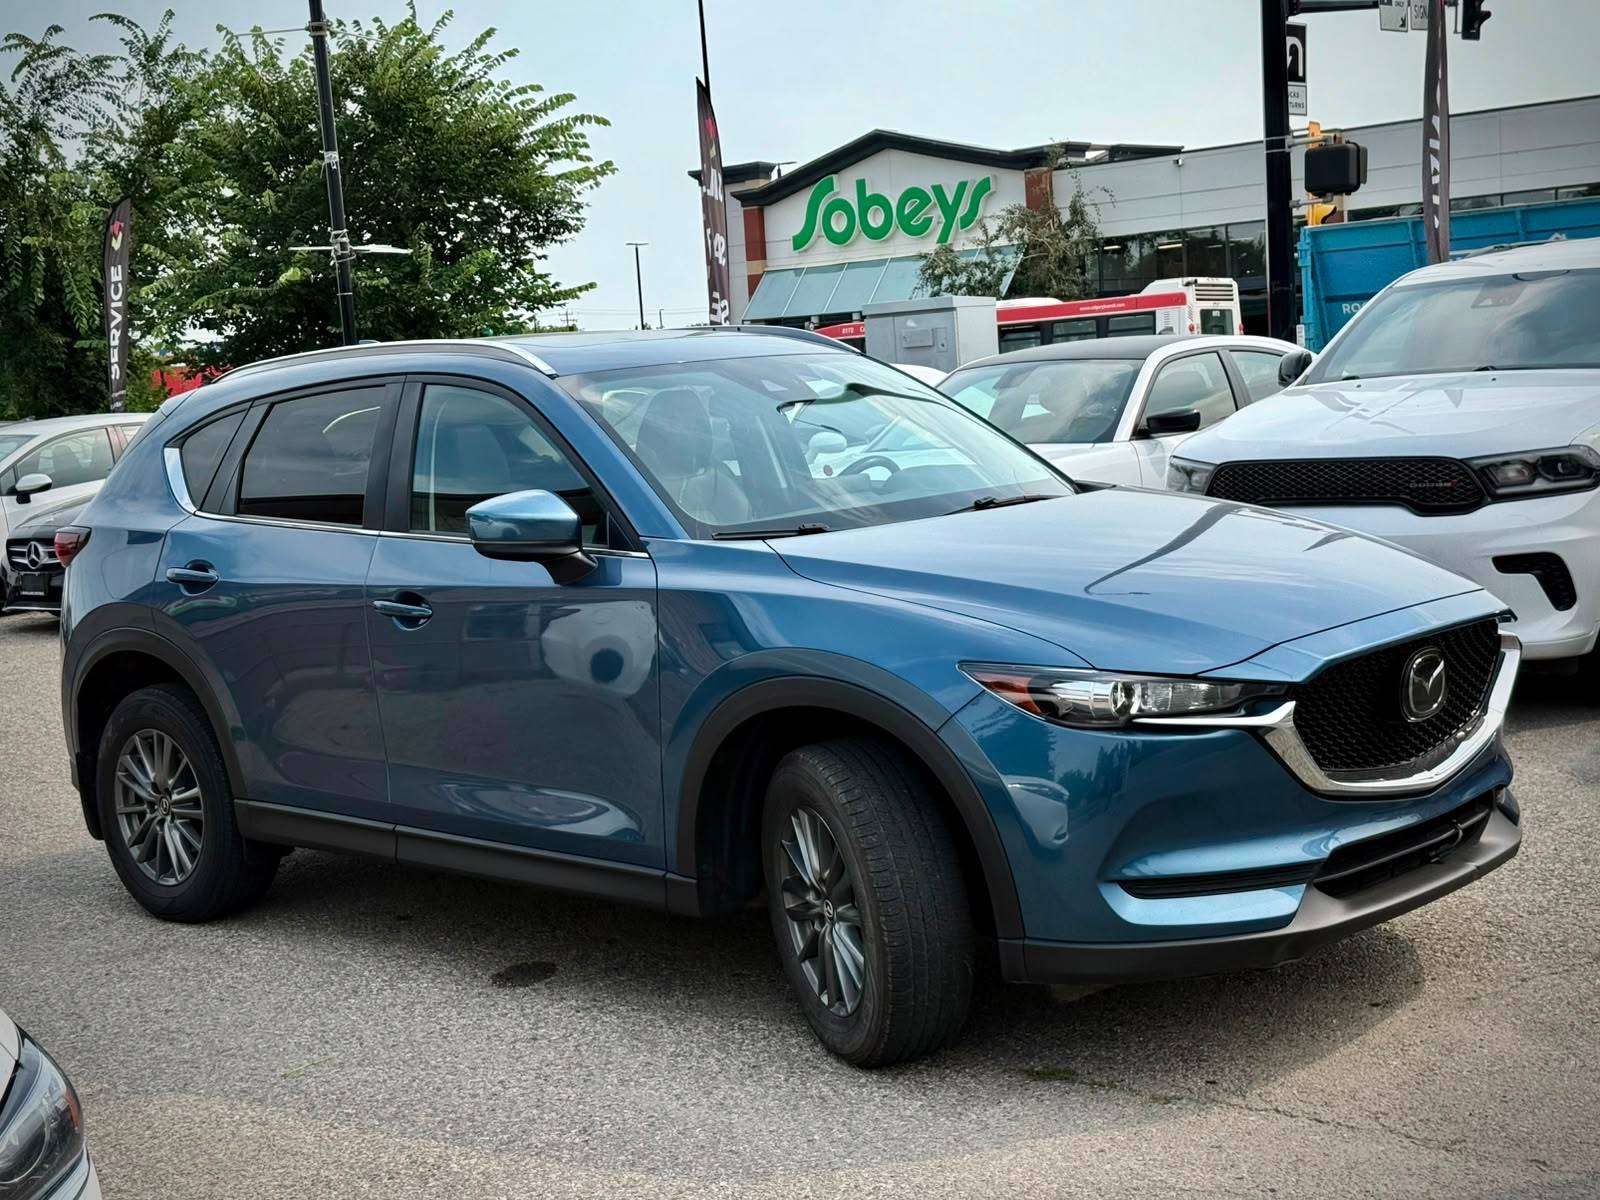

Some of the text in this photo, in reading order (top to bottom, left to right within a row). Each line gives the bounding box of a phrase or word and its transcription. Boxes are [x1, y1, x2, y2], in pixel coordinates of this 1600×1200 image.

[1413, 4, 1428, 19] SIGN
[791, 174, 991, 251] Sobeys
[110, 264, 123, 380] SERVICE
